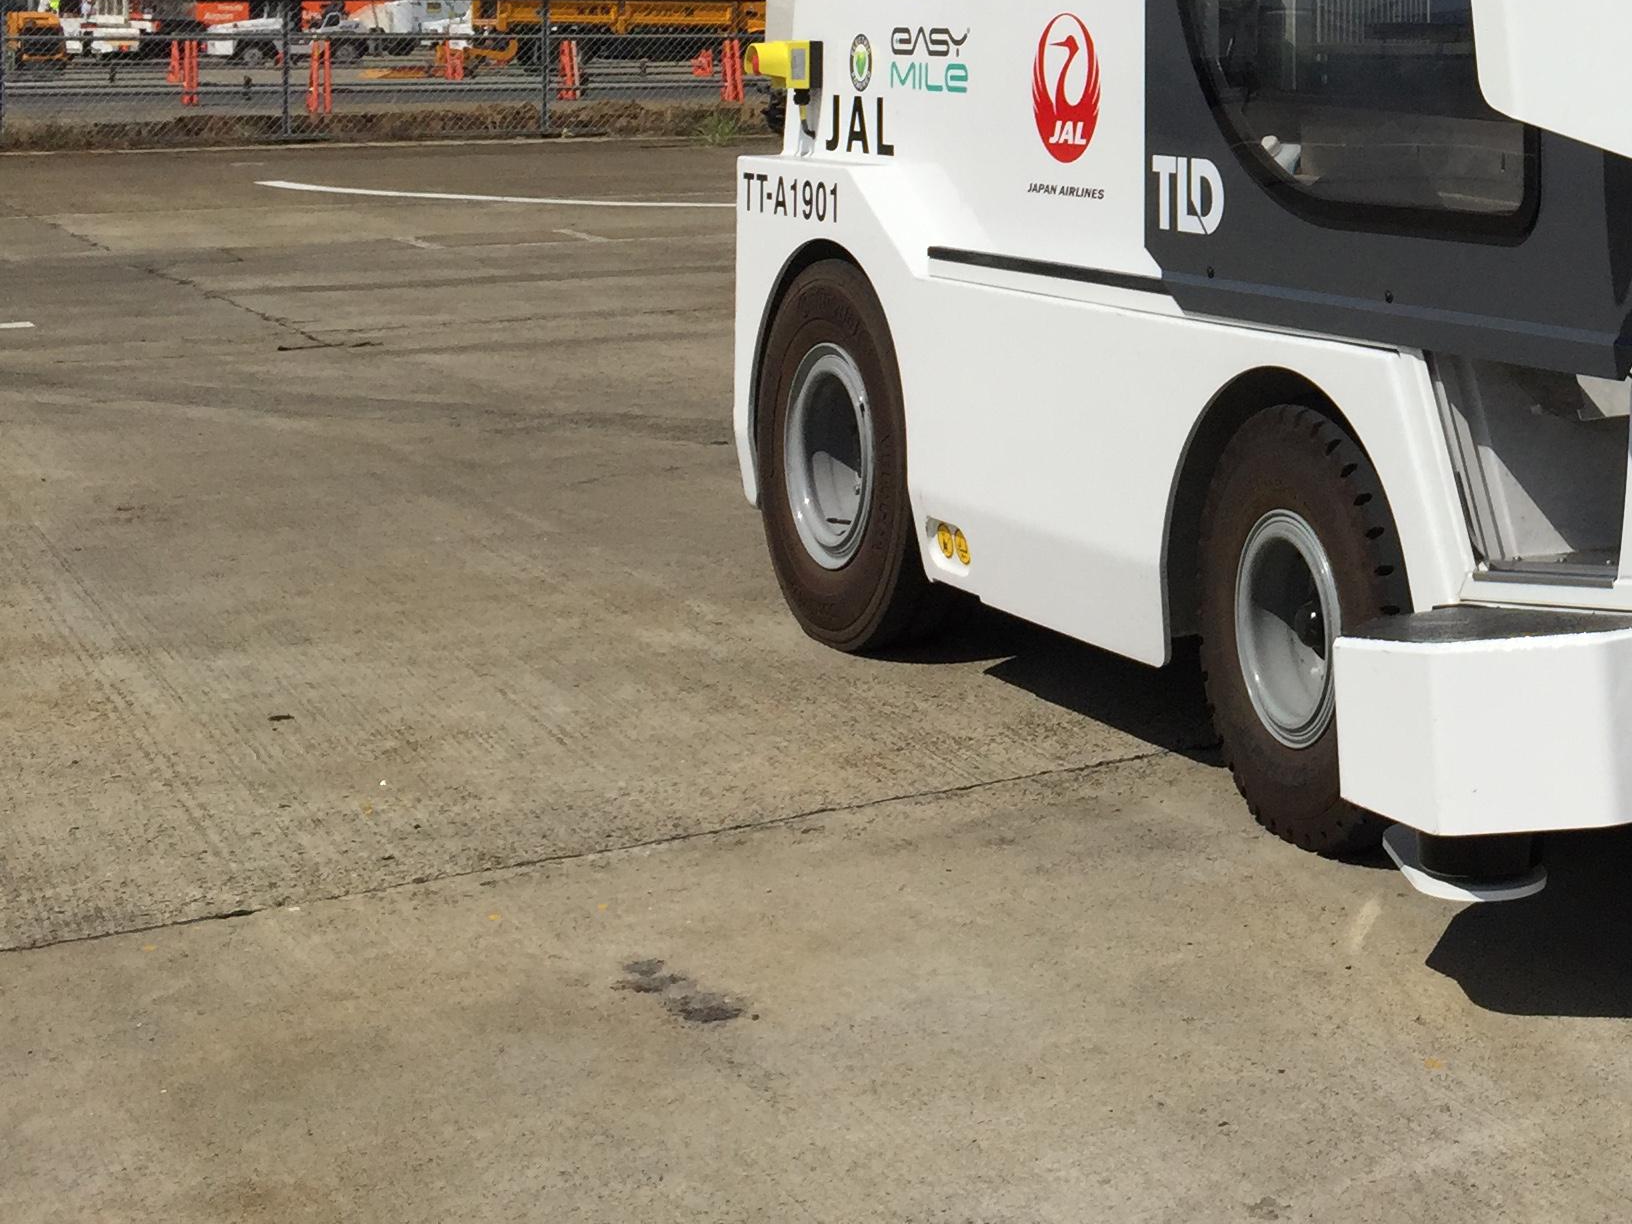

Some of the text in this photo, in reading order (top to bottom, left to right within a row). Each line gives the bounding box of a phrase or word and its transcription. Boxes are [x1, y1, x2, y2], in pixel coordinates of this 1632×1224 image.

[825, 94, 895, 156] JAL
[1049, 120, 1087, 145] JAL
[743, 172, 838, 223] TT-A1901
[1027, 182, 1105, 200] JAPAN AIRLINES
[1152, 154, 1225, 235] TLD
